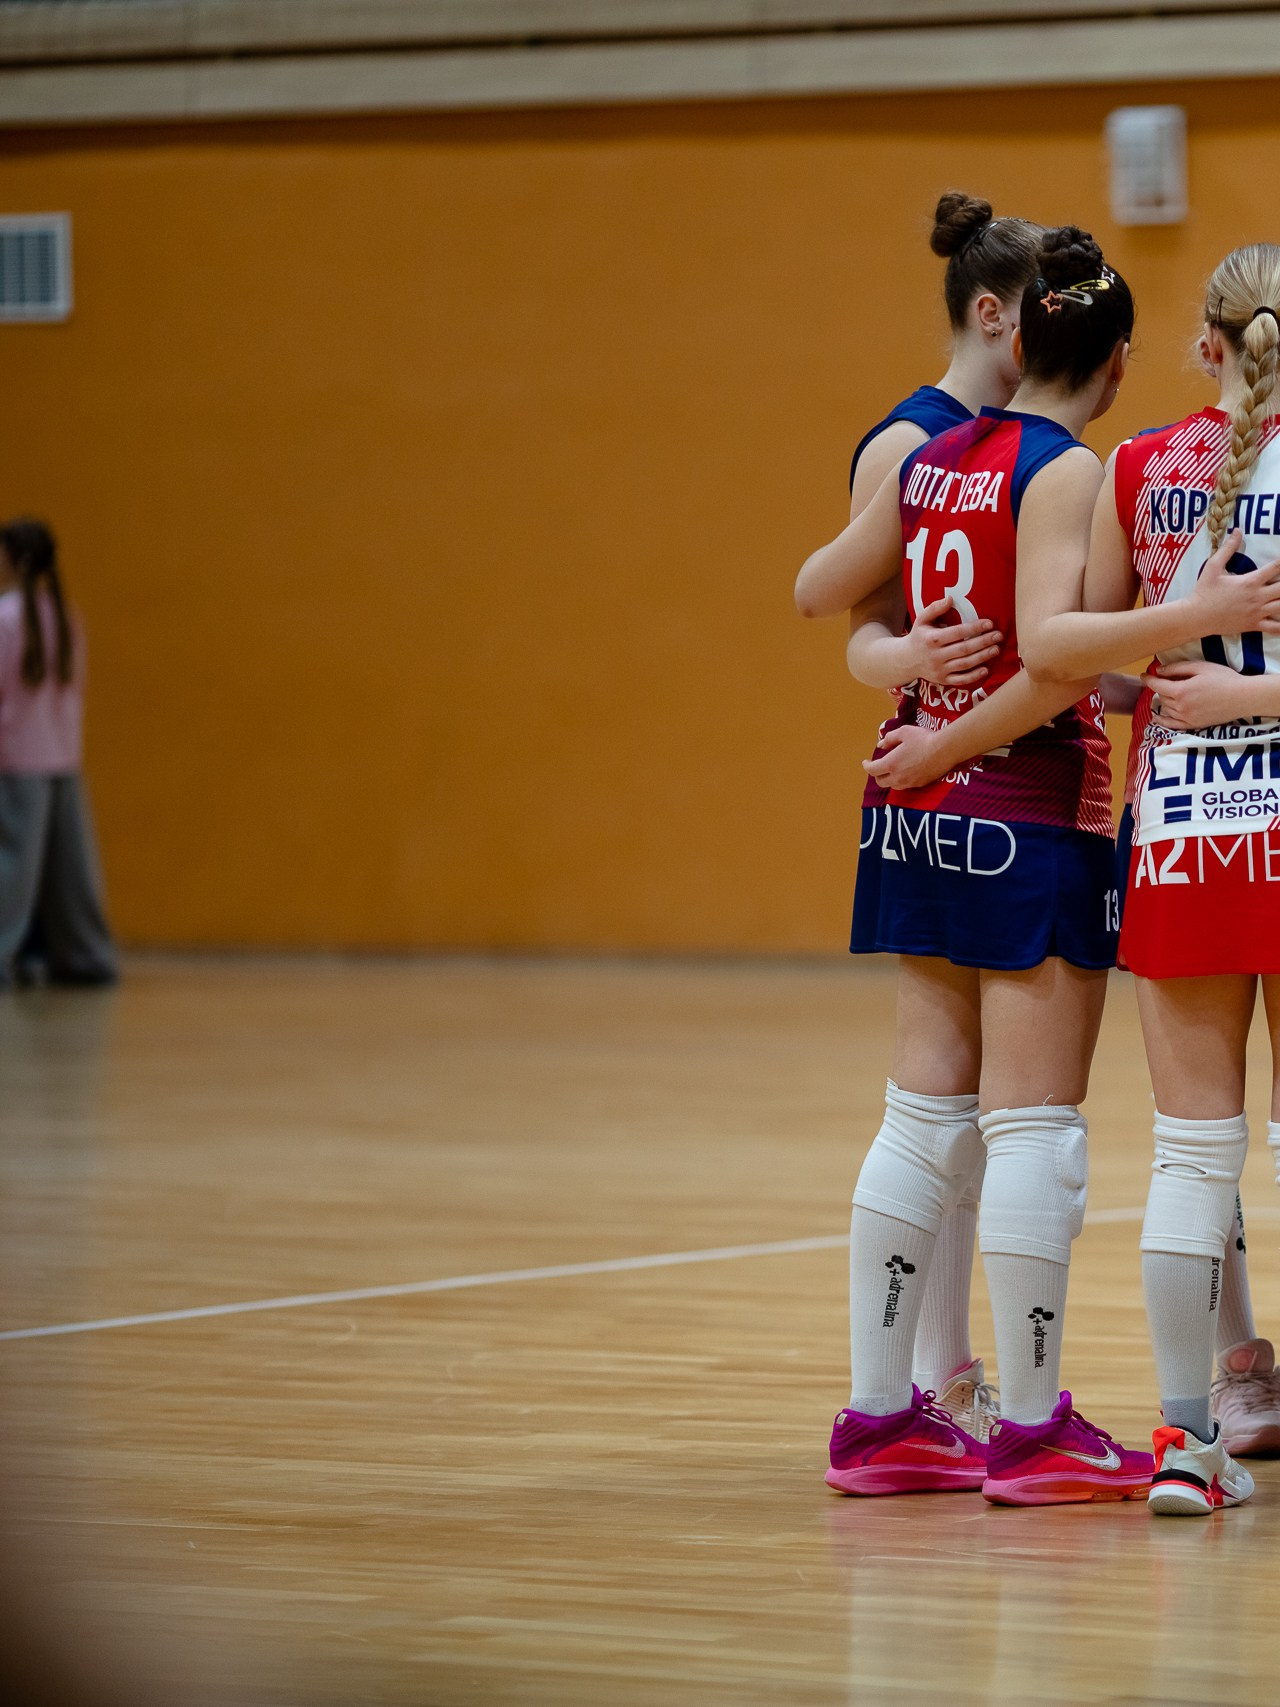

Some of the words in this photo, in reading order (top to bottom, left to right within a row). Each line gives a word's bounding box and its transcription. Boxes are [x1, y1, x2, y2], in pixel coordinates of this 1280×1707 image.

[906, 527, 979, 626] 13
[1203, 803, 1279, 820] VISION
[1104, 888, 1120, 932] 13
[1209, 1257, 1221, 1313] drenalina
